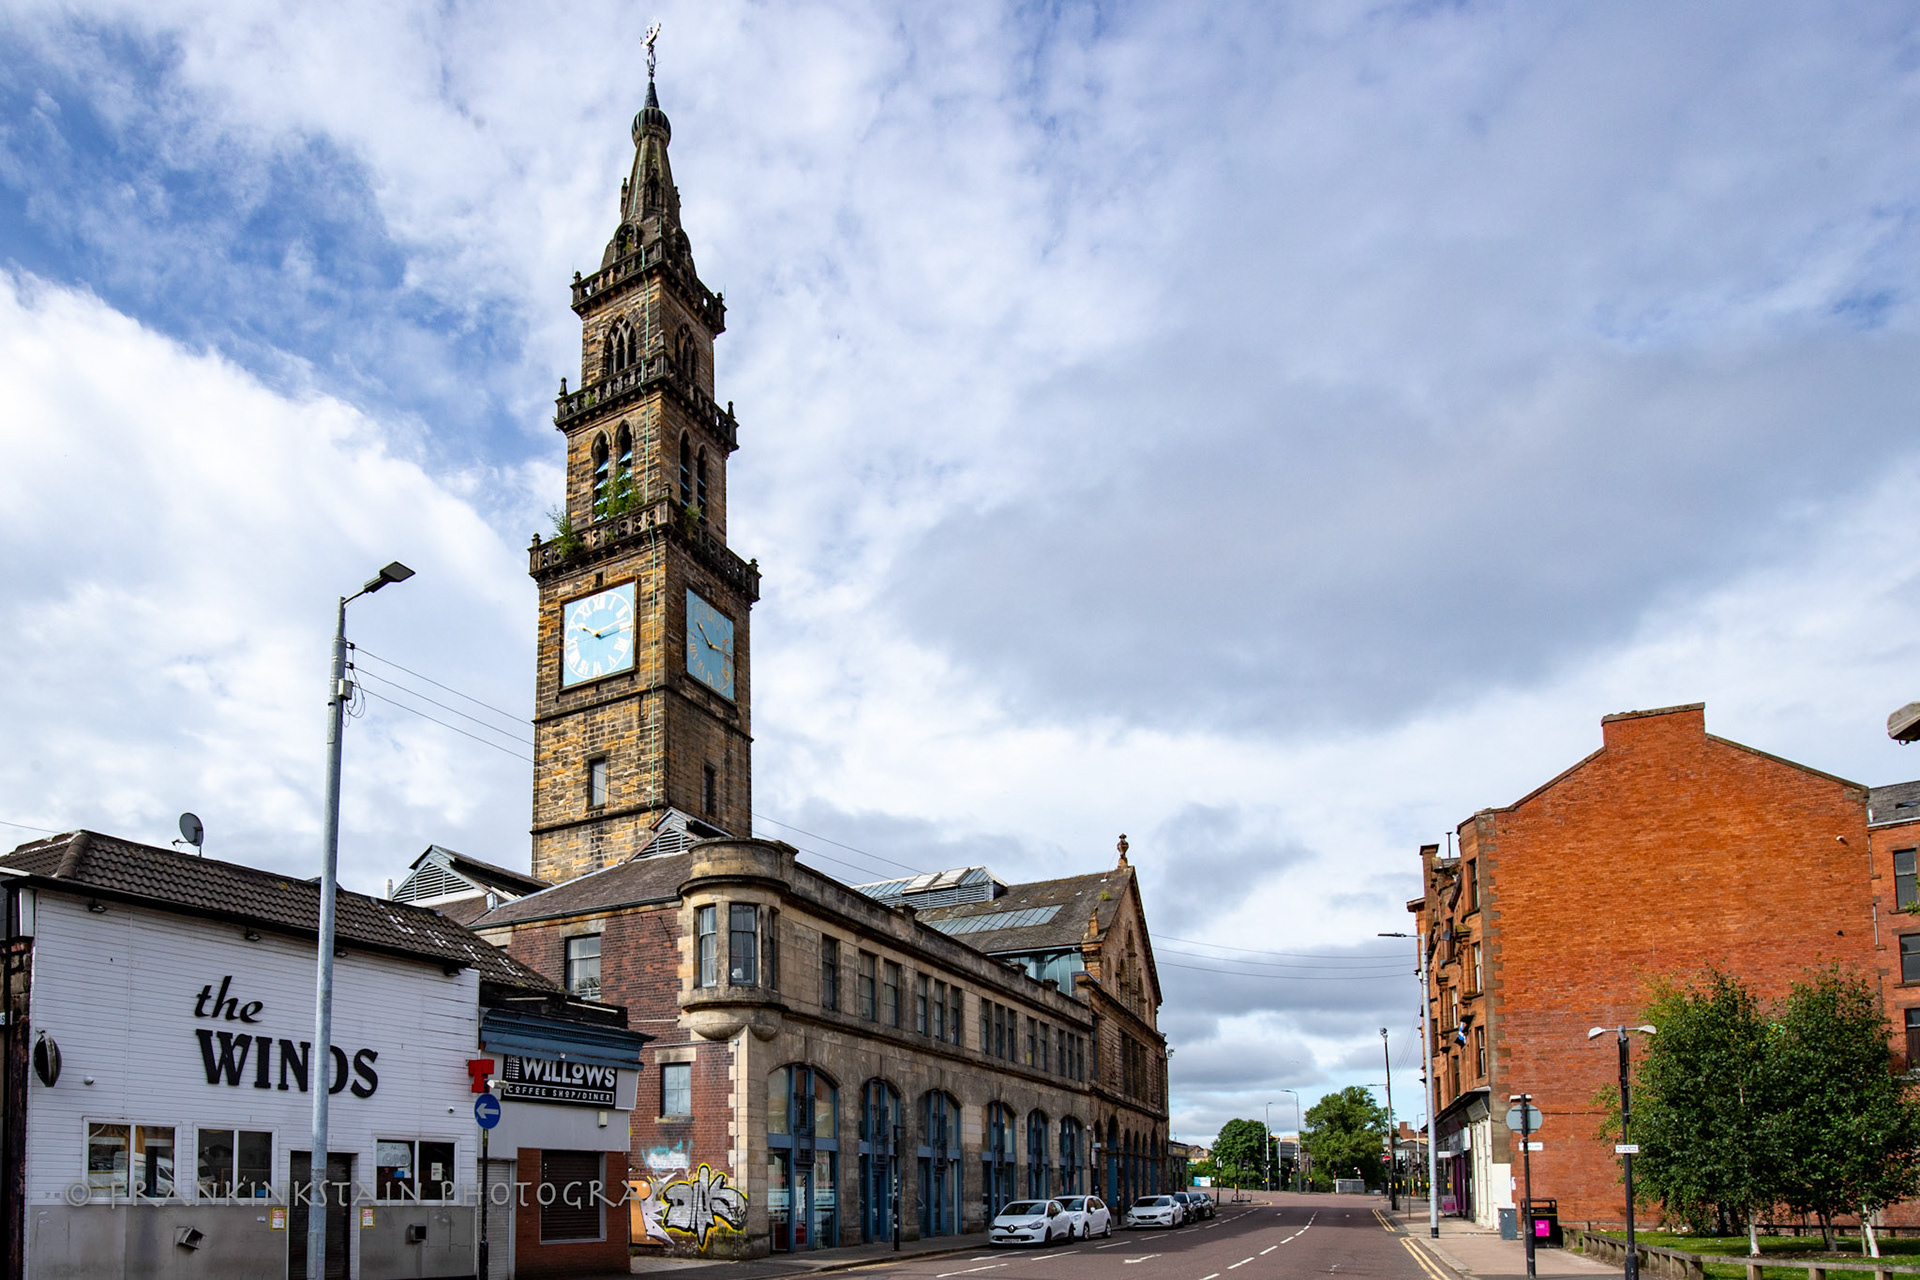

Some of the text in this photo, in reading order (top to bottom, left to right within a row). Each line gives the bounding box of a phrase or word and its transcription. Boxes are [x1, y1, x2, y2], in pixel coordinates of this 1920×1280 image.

[194, 975, 264, 1024] the
[195, 1028, 379, 1099] WINDS
[521, 1056, 616, 1088] WILLOWS
[507, 1084, 547, 1096] COFFEE
